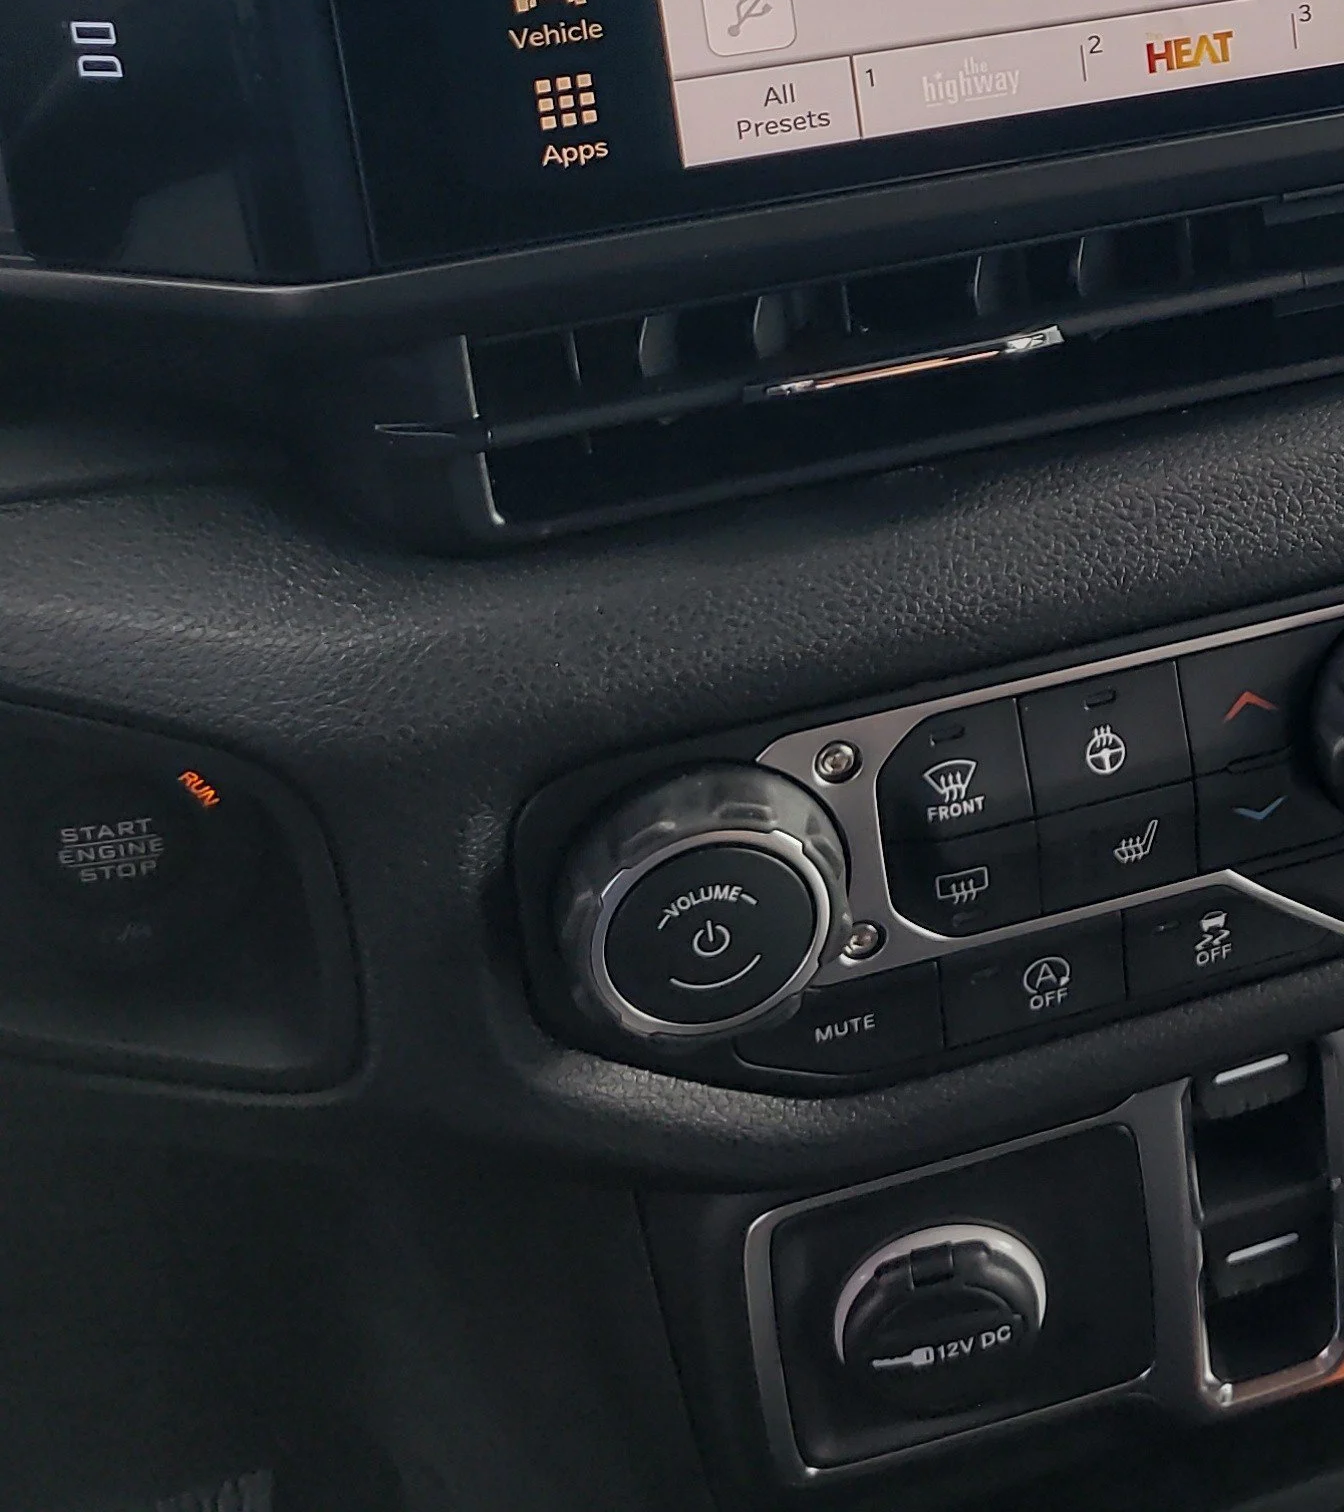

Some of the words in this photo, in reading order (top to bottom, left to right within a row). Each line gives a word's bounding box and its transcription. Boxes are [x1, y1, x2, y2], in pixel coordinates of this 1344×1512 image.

[1299, 4, 1311, 22] 3
[509, 20, 603, 50] Vehicle
[1088, 35, 1103, 54] 2
[70, 21, 123, 78] DO
[1146, 31, 1233, 74] HEAT
[865, 68, 876, 88] 1
[922, 70, 1019, 104] highway
[764, 83, 796, 106] All
[737, 108, 831, 140] Presets
[542, 141, 608, 168] Apps
[178, 770, 221, 807] RUN
[928, 796, 985, 823] FRONT
[61, 818, 152, 844] START
[59, 838, 165, 865] ENGINE
[80, 859, 157, 882] STOP
[663, 884, 742, 917] VOLUME
[1196, 942, 1232, 967] OFF
[1029, 988, 1069, 1011] OFF
[815, 1013, 876, 1043] MUTE
[937, 1336, 974, 1361] 12V
[981, 1325, 1011, 1348] DC
